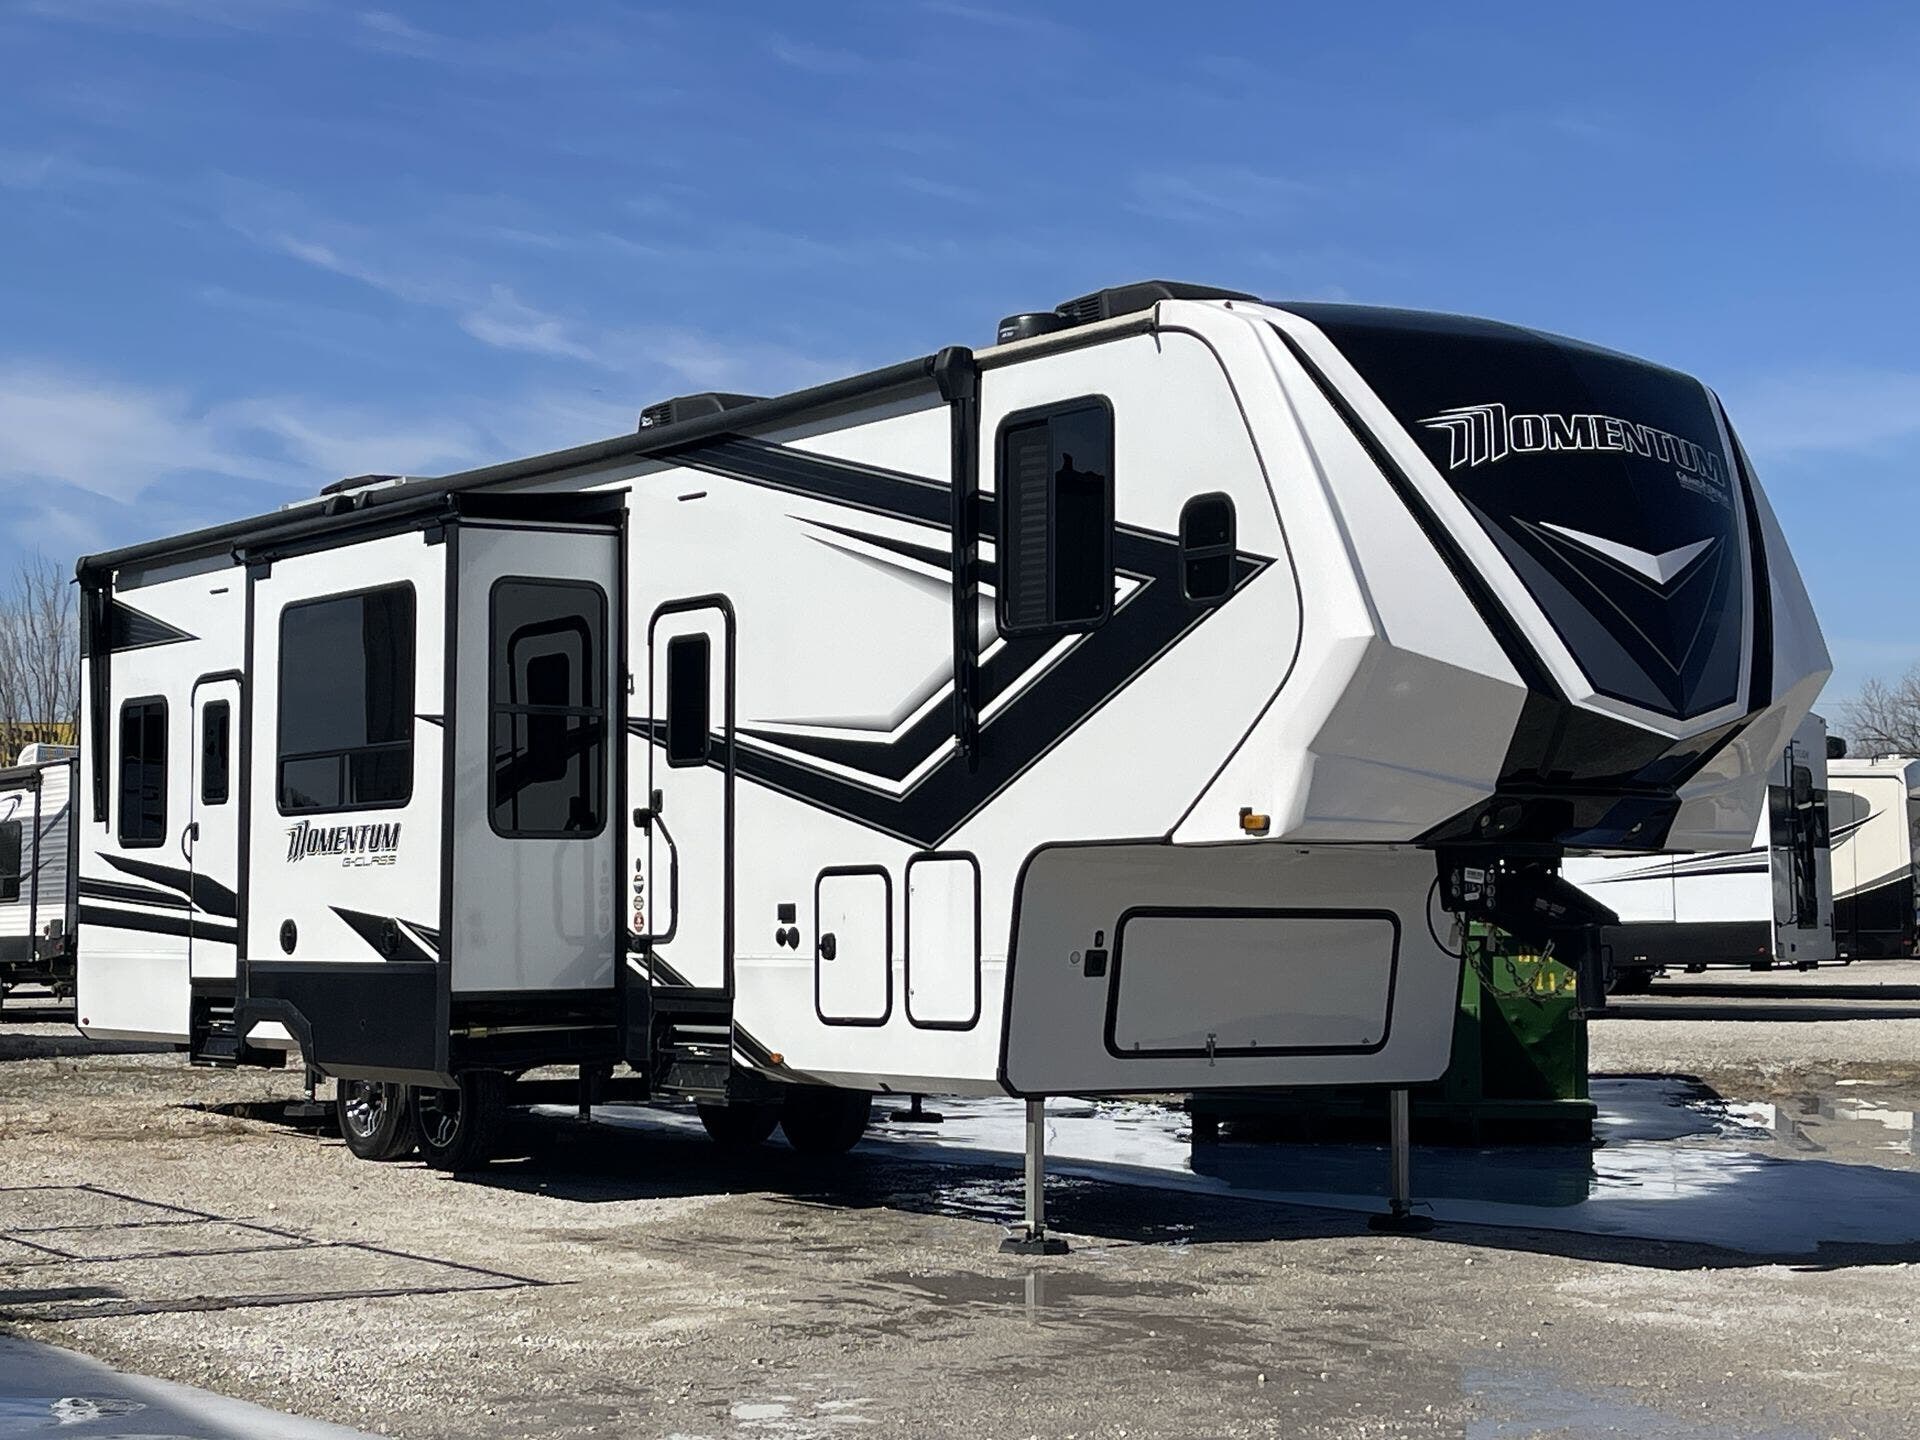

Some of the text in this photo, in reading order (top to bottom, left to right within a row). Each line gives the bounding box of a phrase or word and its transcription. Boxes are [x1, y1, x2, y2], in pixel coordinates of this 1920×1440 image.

[1416, 403, 1726, 487] MOMENTUM
[284, 820, 401, 862] MOMENTUM
[342, 855, 397, 867] G-CLASS
